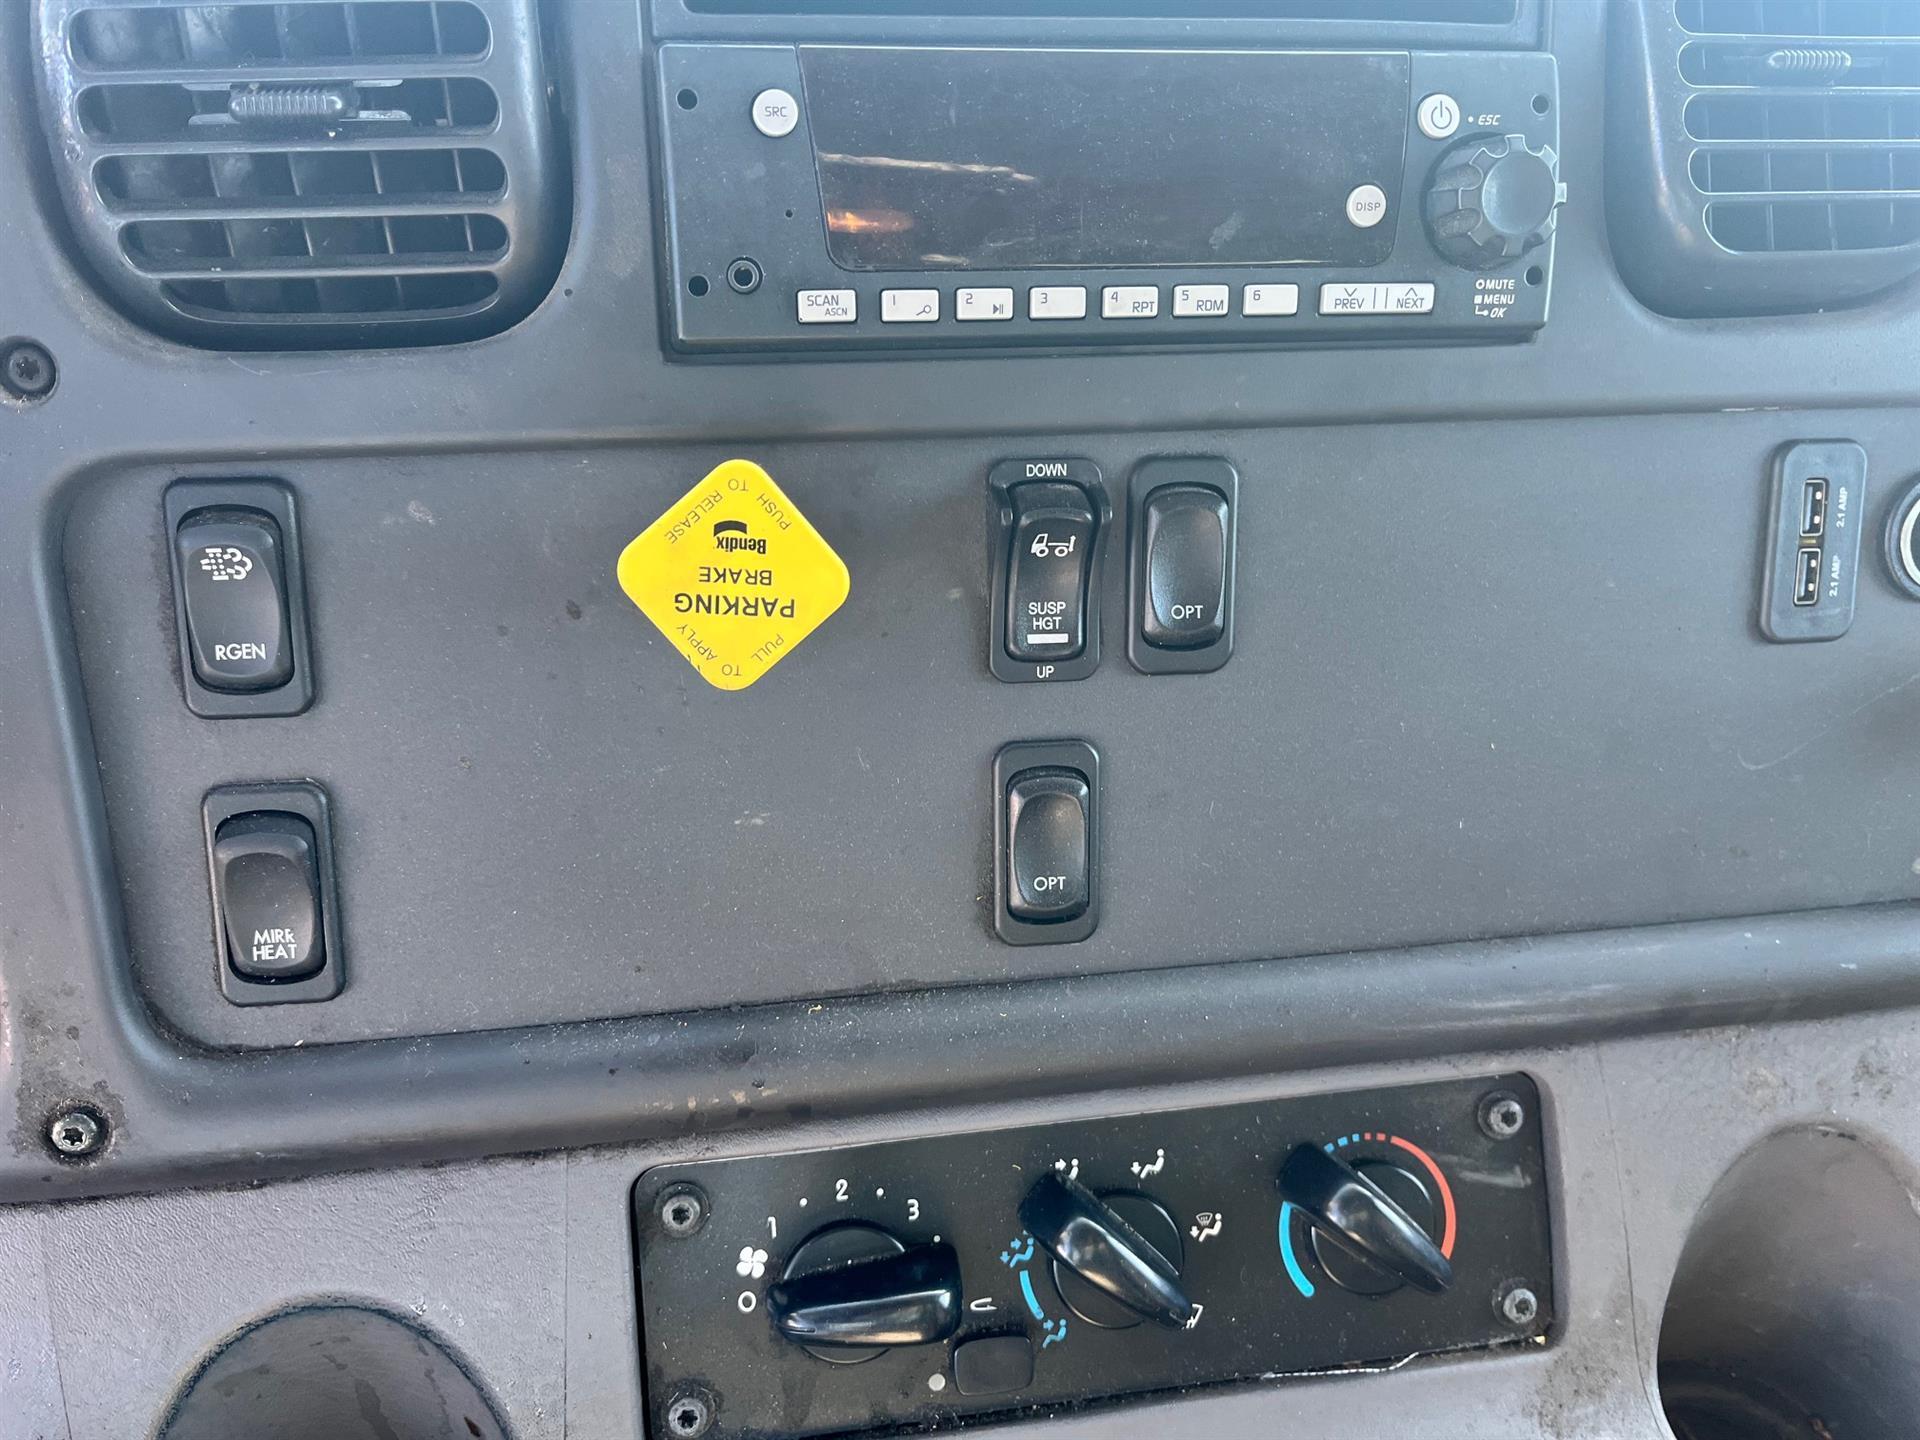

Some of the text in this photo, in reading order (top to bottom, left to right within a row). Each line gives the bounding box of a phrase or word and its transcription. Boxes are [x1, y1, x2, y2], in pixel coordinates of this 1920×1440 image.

[764, 106, 787, 117] SRC
[1478, 113, 1500, 126] ESC
[1355, 201, 1381, 212] DISP
[1486, 279, 1515, 290] MUTE
[806, 293, 839, 307] SCAN
[891, 294, 897, 306] 1
[965, 294, 974, 306] 2
[1040, 292, 1049, 305] 3
[1111, 291, 1119, 304] 4
[1181, 290, 1189, 302] 5
[1253, 290, 1261, 302] 6
[1483, 294, 1515, 305] MENU
[1132, 301, 1155, 313] RPT
[1196, 299, 1224, 312] RDM
[1334, 298, 1364, 310] PREV
[1396, 297, 1424, 309] NEXT
[824, 307, 848, 317] ASCN
[1490, 307, 1506, 318] OK
[1026, 463, 1067, 477] DOWN
[664, 478, 792, 544] PUSH TO RELEASE
[1836, 487, 1848, 528] 2.1 AMP
[716, 536, 767, 554] Bendix
[698, 566, 772, 586] BRAKE
[1829, 554, 1841, 597] 2.1 AMP
[674, 592, 795, 618] PARKING
[1028, 602, 1066, 615] SUSP
[1171, 605, 1203, 619] OPT
[1032, 617, 1062, 630] HGT
[215, 643, 266, 660] RGEN
[677, 624, 785, 676] PULL TO APPLY
[1036, 666, 1055, 678] UP
[1033, 876, 1065, 891] OPT
[252, 944, 298, 961] HEAT
[835, 1179, 849, 1200] 2
[908, 1199, 920, 1220] 3
[767, 1217, 776, 1238] 1
